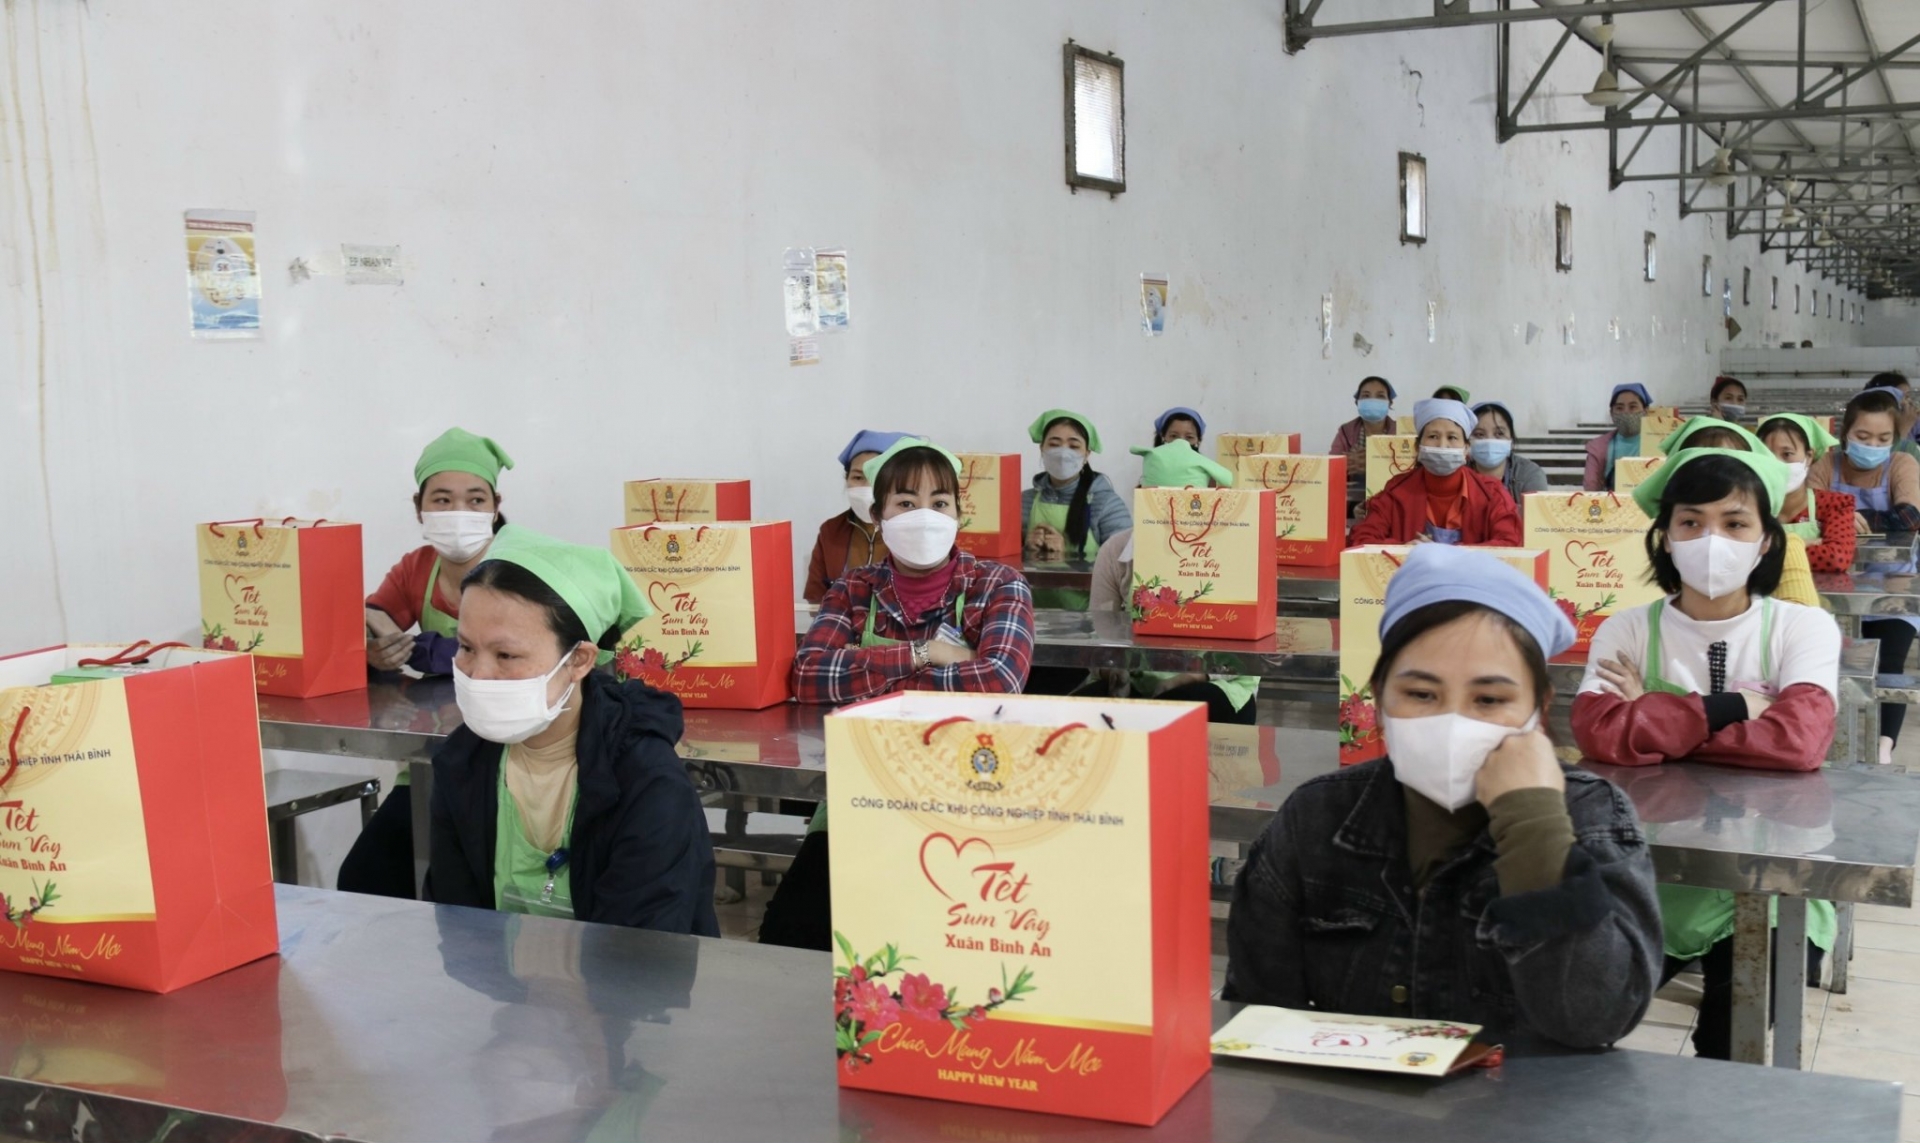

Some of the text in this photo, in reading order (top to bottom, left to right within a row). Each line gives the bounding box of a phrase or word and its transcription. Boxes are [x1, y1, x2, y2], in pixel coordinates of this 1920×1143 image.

[851, 796, 884, 809] CÔNG
[947, 803, 967, 815] KHU
[969, 803, 1004, 818] CÔNG
[947, 903, 996, 928] Sum
[945, 933, 984, 951] Xuân
[1029, 942, 1051, 957] An
[938, 1068, 1039, 1091] HAPPY NEW YEAR
